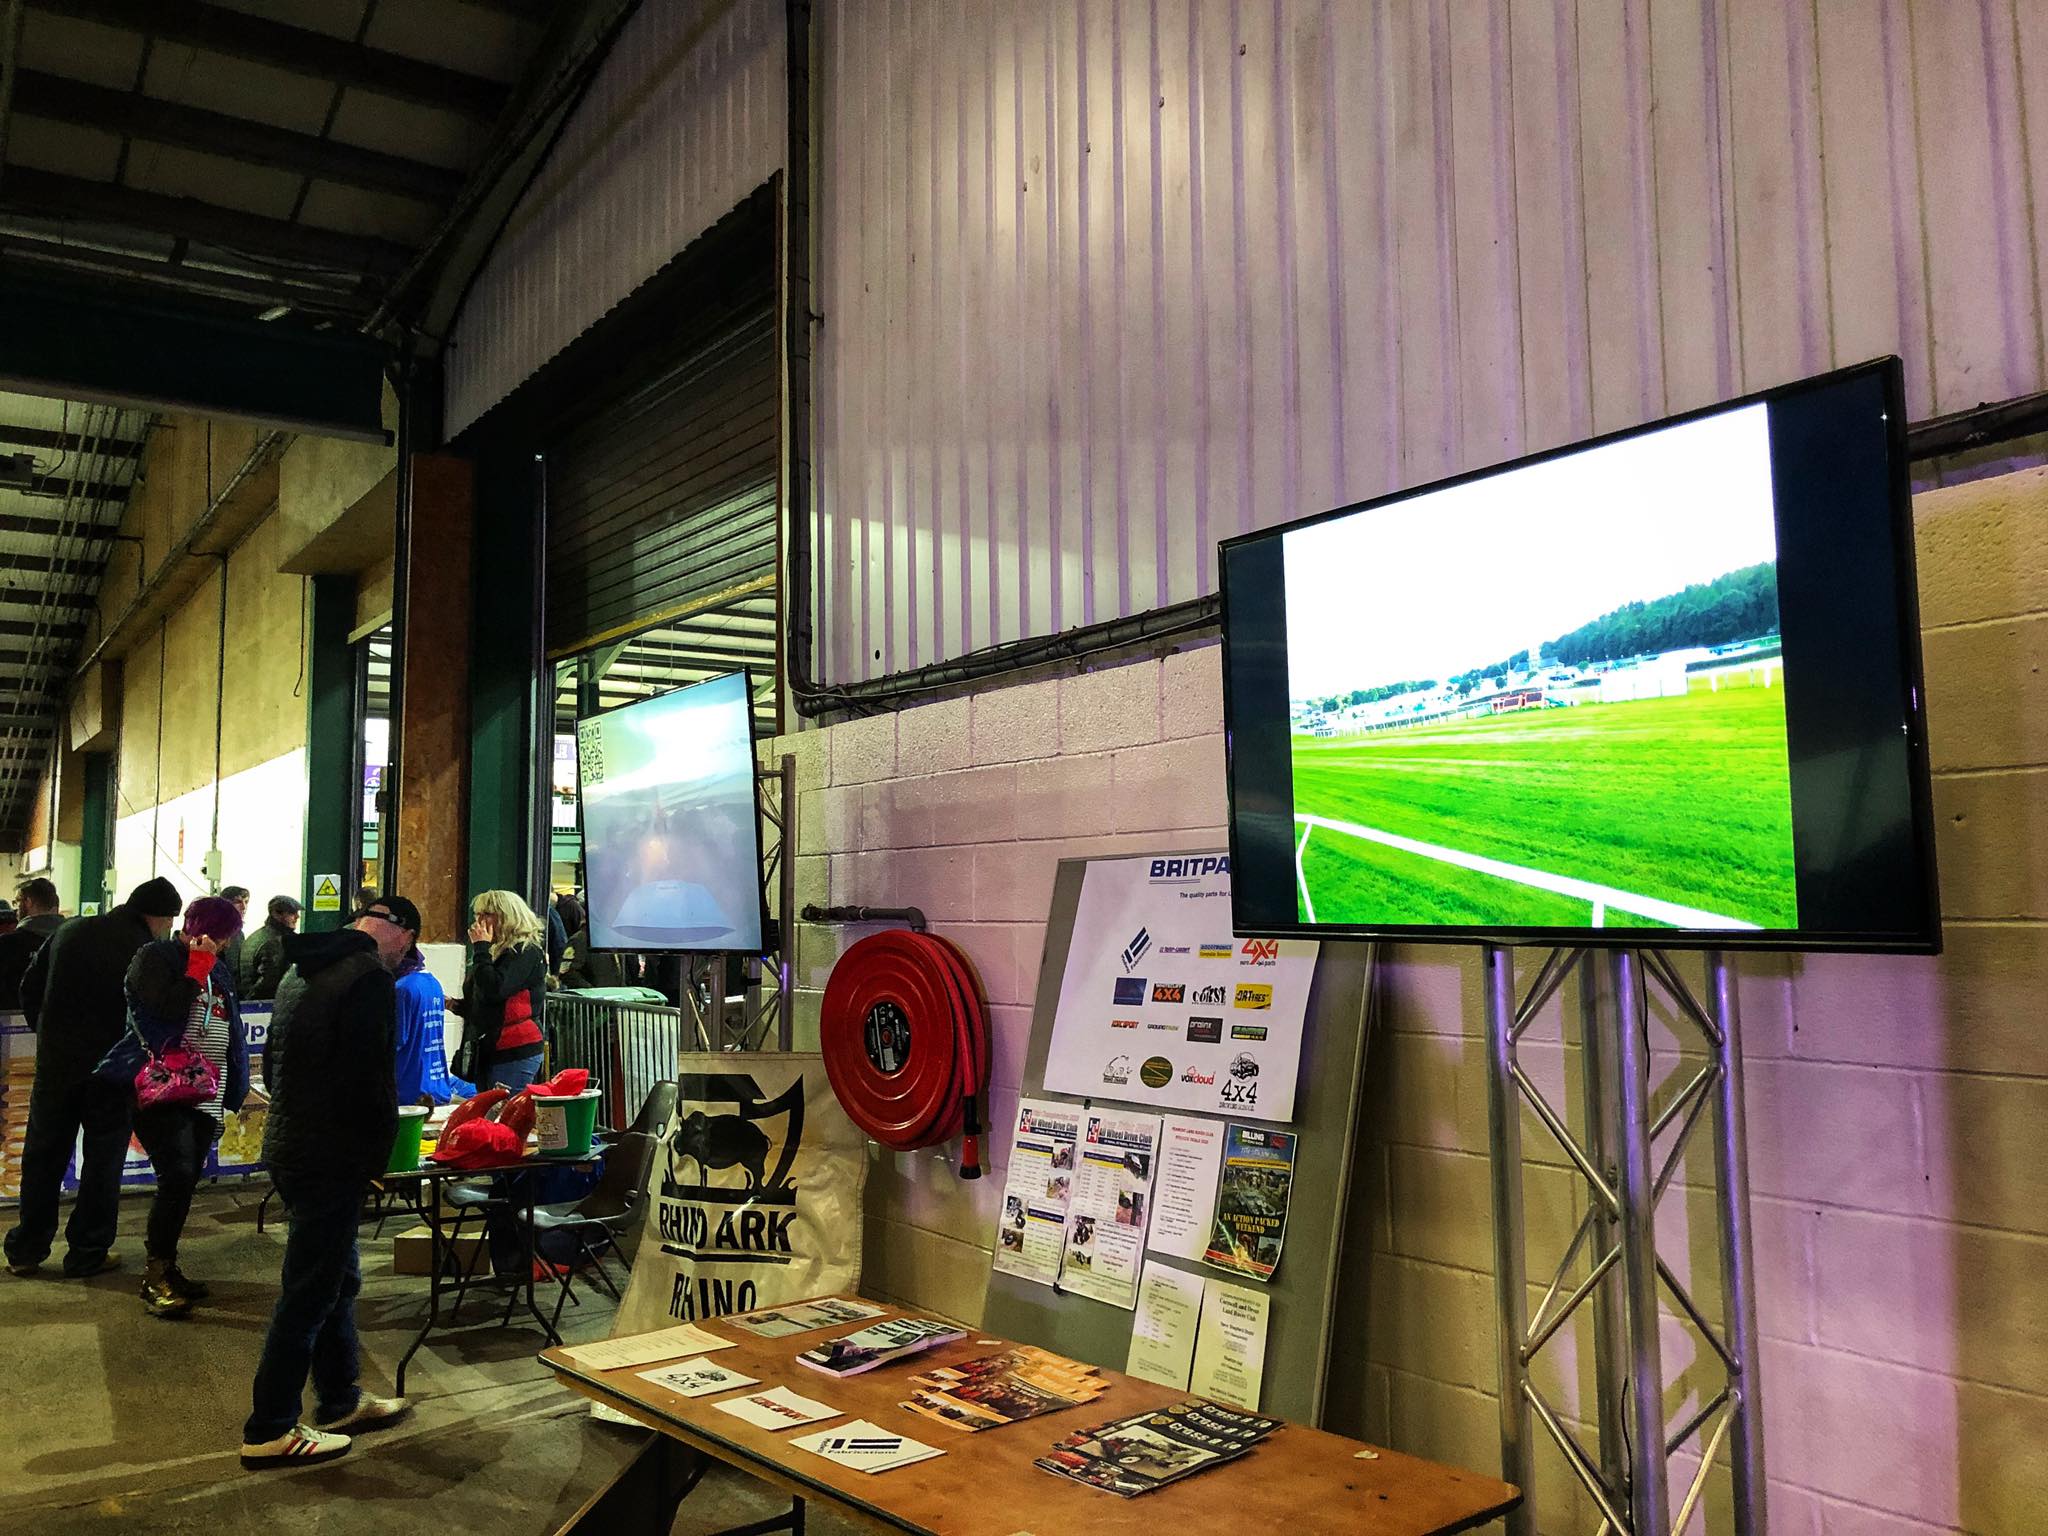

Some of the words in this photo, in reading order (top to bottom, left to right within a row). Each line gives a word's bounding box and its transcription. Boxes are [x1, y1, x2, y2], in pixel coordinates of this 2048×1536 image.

[1149, 856, 1231, 877] BRITPA
[1181, 1073, 1215, 1085] voxcloud
[1107, 1129, 1123, 1138] Wheel
[1233, 1214, 1254, 1224] ACTION
[1254, 1216, 1280, 1227] PACKED
[715, 1210, 797, 1252] ARK
[1235, 1223, 1265, 1234] WEEKEND
